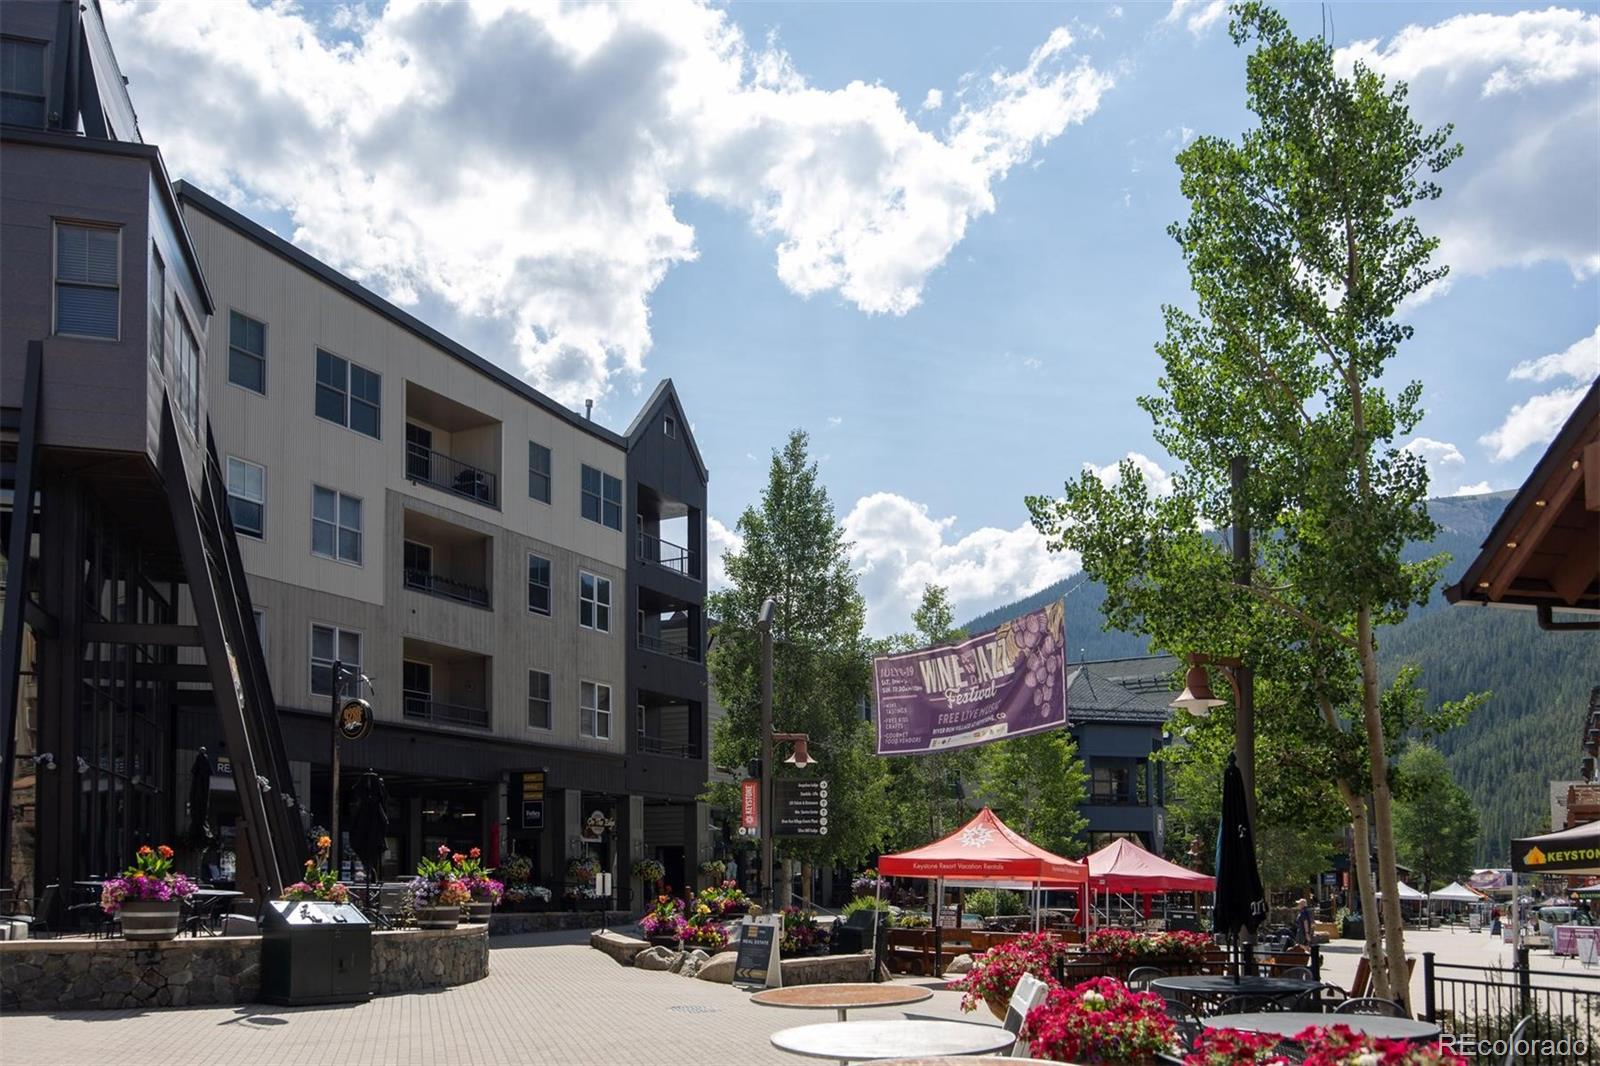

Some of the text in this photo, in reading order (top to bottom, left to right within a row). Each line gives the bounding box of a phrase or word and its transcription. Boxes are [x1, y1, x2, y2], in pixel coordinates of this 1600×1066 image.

[919, 654, 969, 694] WINE
[971, 638, 1016, 684] JAZZ
[944, 679, 997, 709] Festival
[938, 711, 960, 725] FREE
[961, 707, 978, 722] LIVE
[996, 711, 1007, 720] CO
[217, 763, 233, 773] RE
[745, 784, 753, 814] KEYSTONE
